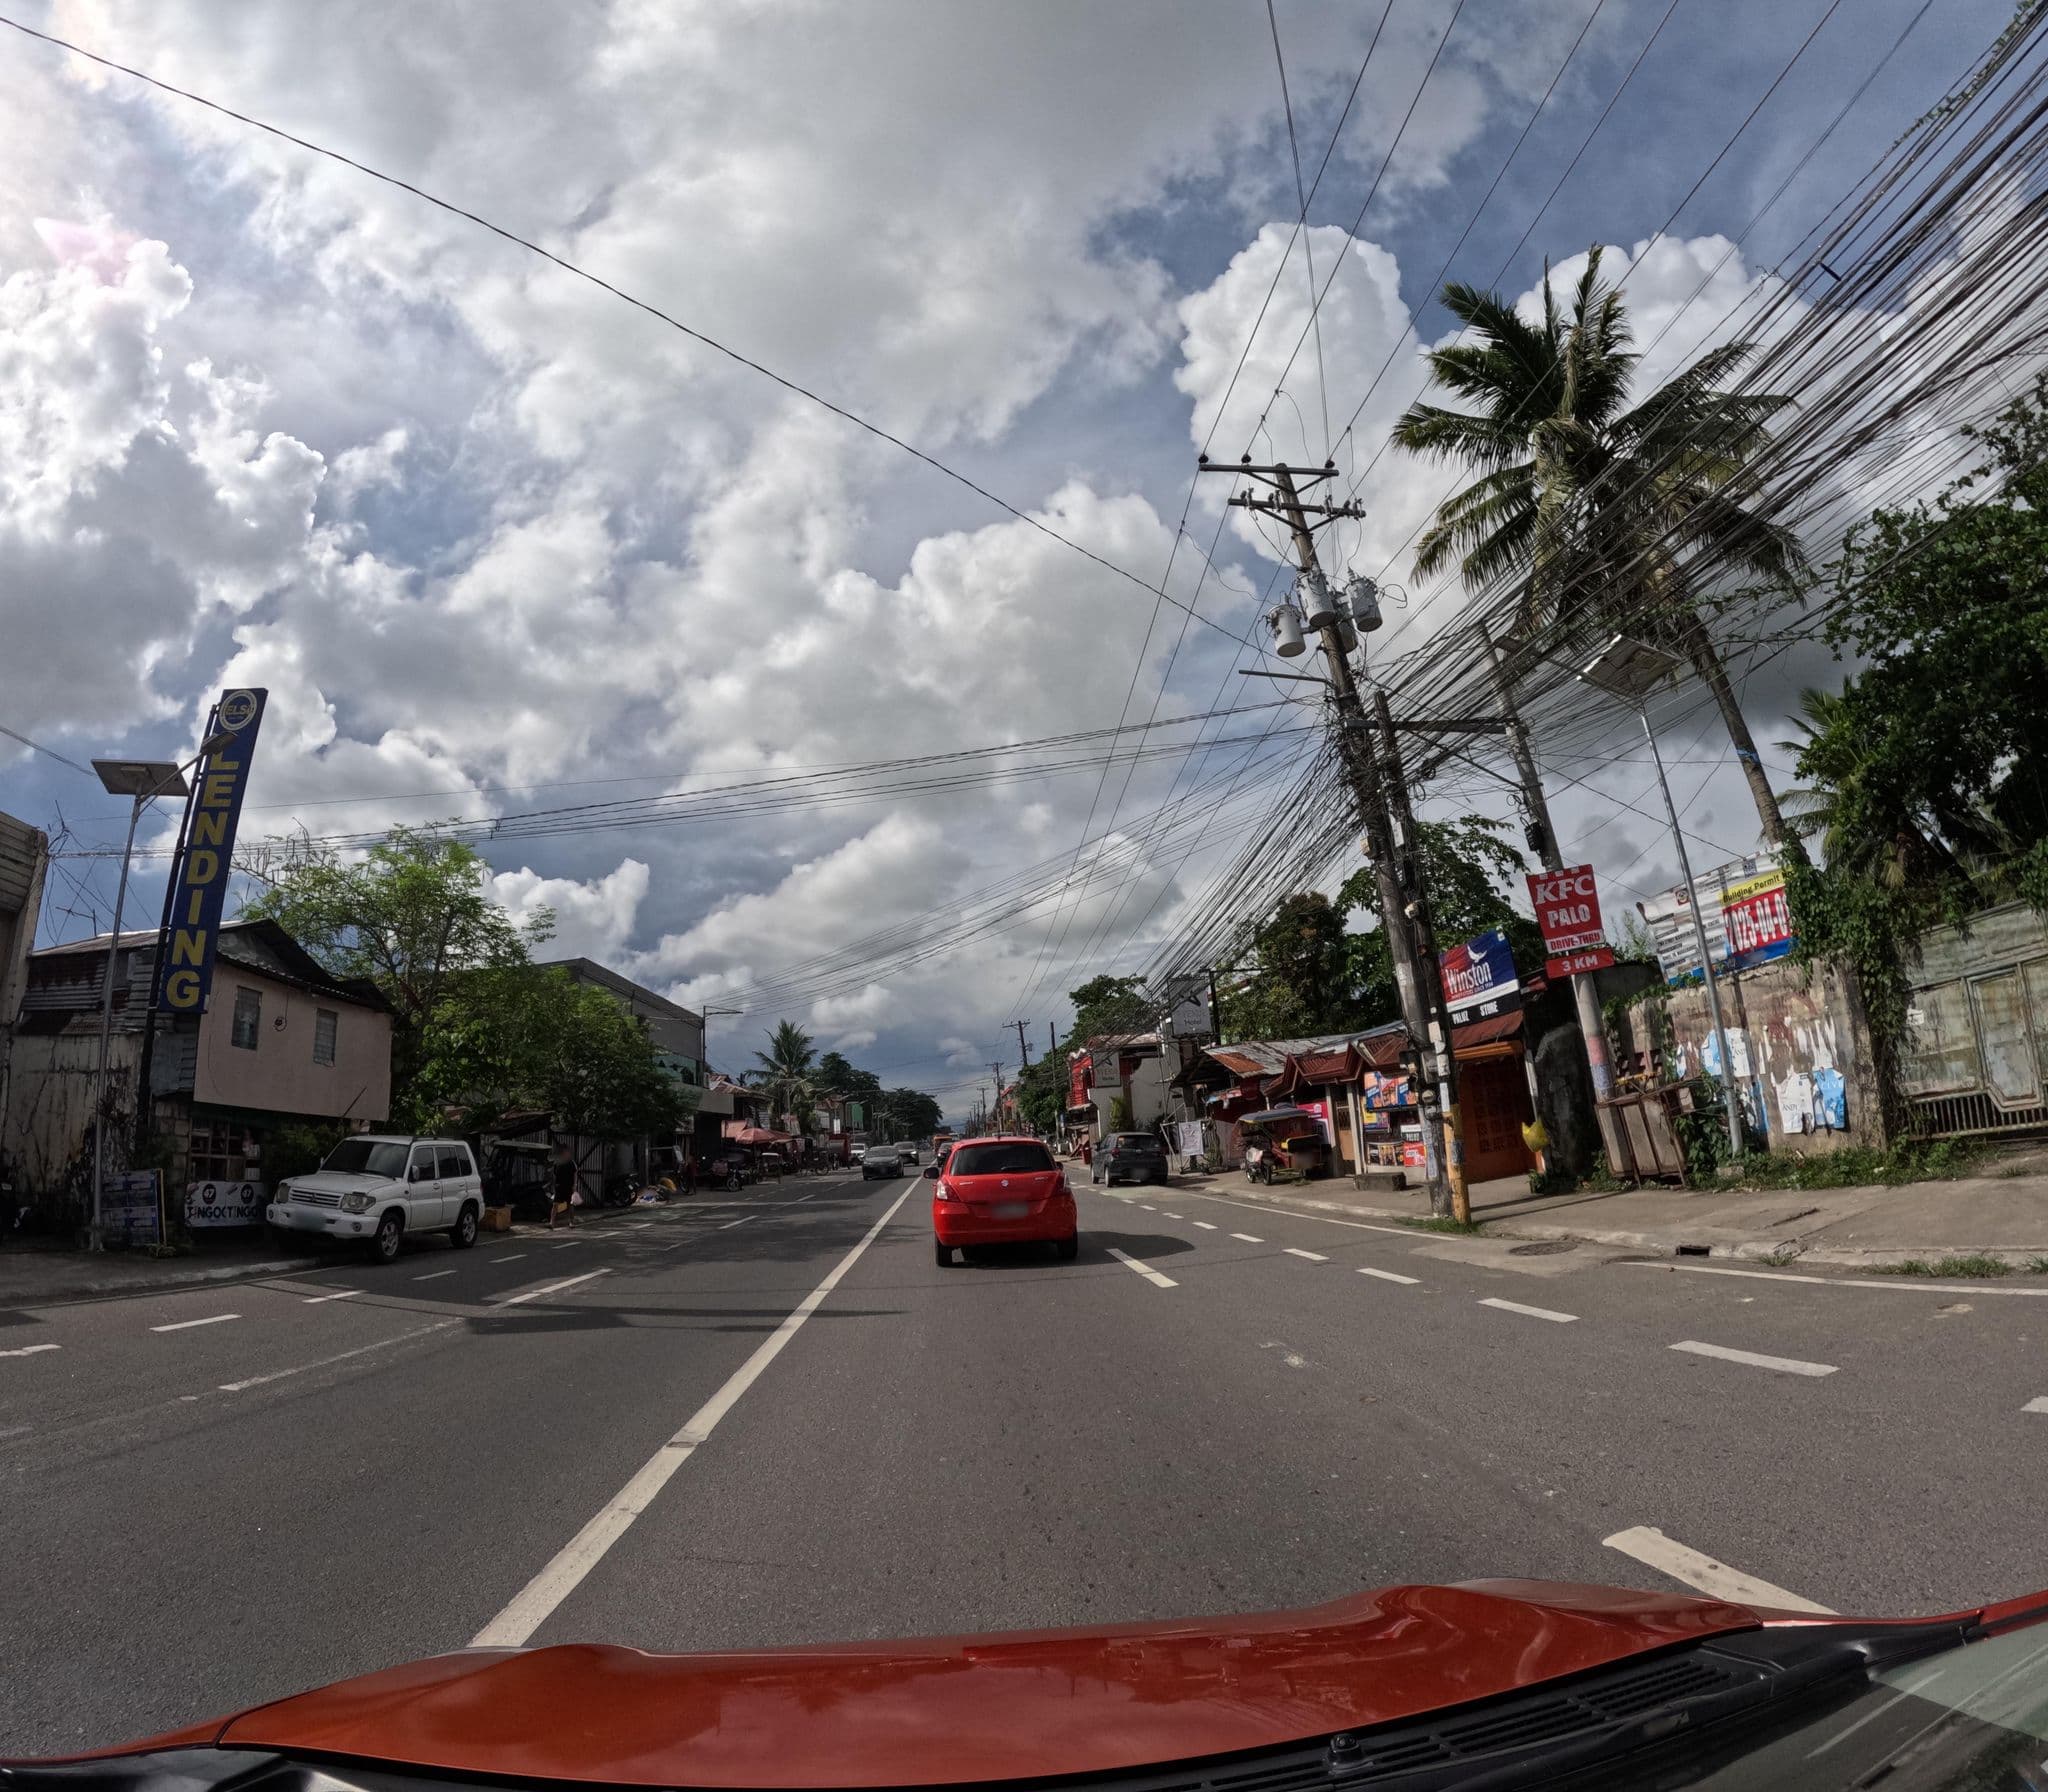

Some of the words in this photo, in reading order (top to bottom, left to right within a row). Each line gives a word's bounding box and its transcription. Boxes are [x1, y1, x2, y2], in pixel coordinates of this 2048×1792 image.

[166, 751, 239, 1008] LENDING
[1535, 874, 1594, 905] KFC
[1723, 885, 1753, 903] Building
[1754, 874, 1781, 891] Permit
[1547, 903, 1591, 929] PALO
[1445, 961, 1492, 995] Winston
[1561, 960, 1571, 972] 3
[1574, 955, 1599, 969] KM
[1480, 1000, 1499, 1017] STORE
